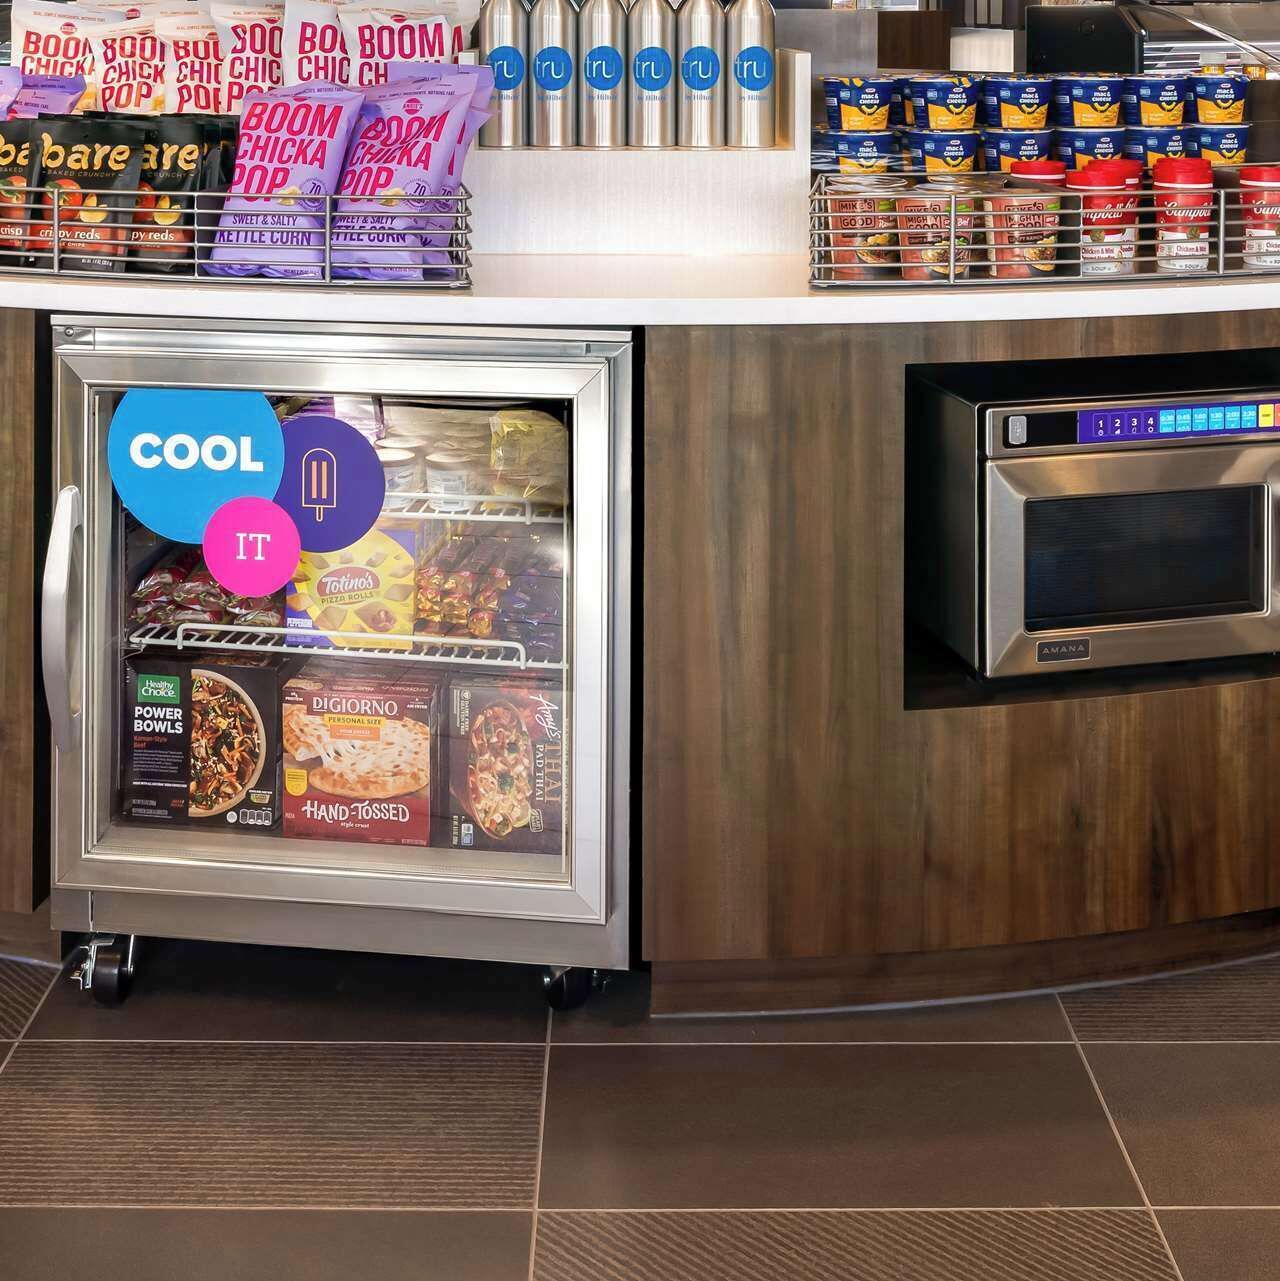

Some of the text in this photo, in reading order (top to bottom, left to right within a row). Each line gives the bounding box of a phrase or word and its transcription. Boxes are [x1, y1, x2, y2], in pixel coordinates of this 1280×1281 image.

[358, 22, 445, 60] BOOM
[536, 56, 565, 79] tru
[586, 56, 615, 79] tru
[635, 56, 664, 79] tru
[683, 56, 712, 79] tru
[734, 56, 766, 79] tru
[101, 81, 153, 112] POP
[241, 102, 344, 140] BOOM
[360, 110, 449, 148] BOOM
[41, 131, 131, 171] bare
[237, 132, 328, 171] CHICKA
[349, 140, 432, 171] CHICKA
[48, 170, 115, 179] BAKED CRUNCHY
[227, 163, 290, 202] POP
[310, 182, 322, 194] 70
[339, 166, 394, 202] POP
[415, 182, 426, 196] 70
[232, 214, 298, 227] SWEET & SALTY
[336, 215, 396, 225] WEET & SALTY
[842, 217, 873, 227] GOOD
[39, 227, 101, 241] cripy reds
[148, 229, 175, 242] reds
[218, 230, 312, 246] KETTLE CORN
[368, 226, 407, 243] CORN
[1098, 420, 1104, 428] 1
[1114, 418, 1121, 427] 2
[1131, 417, 1138, 426] 3
[1147, 416, 1154, 426] 4
[129, 432, 264, 472] COOL
[236, 532, 271, 561] IT
[321, 571, 374, 593] Totino's
[321, 595, 346, 605] PIZZA
[1042, 644, 1085, 655] AMANA
[141, 686, 176, 698] Choice
[145, 679, 175, 691] Healthy
[134, 706, 183, 720] POWER
[328, 717, 382, 726] PERSONAL SIZE
[530, 694, 562, 742] Amy's
[133, 720, 183, 734] BOWLS
[536, 744, 544, 801] PAD THAI
[545, 742, 562, 803] THAI
[301, 800, 410, 823] HAND-TOSSED
[340, 821, 354, 829] style
